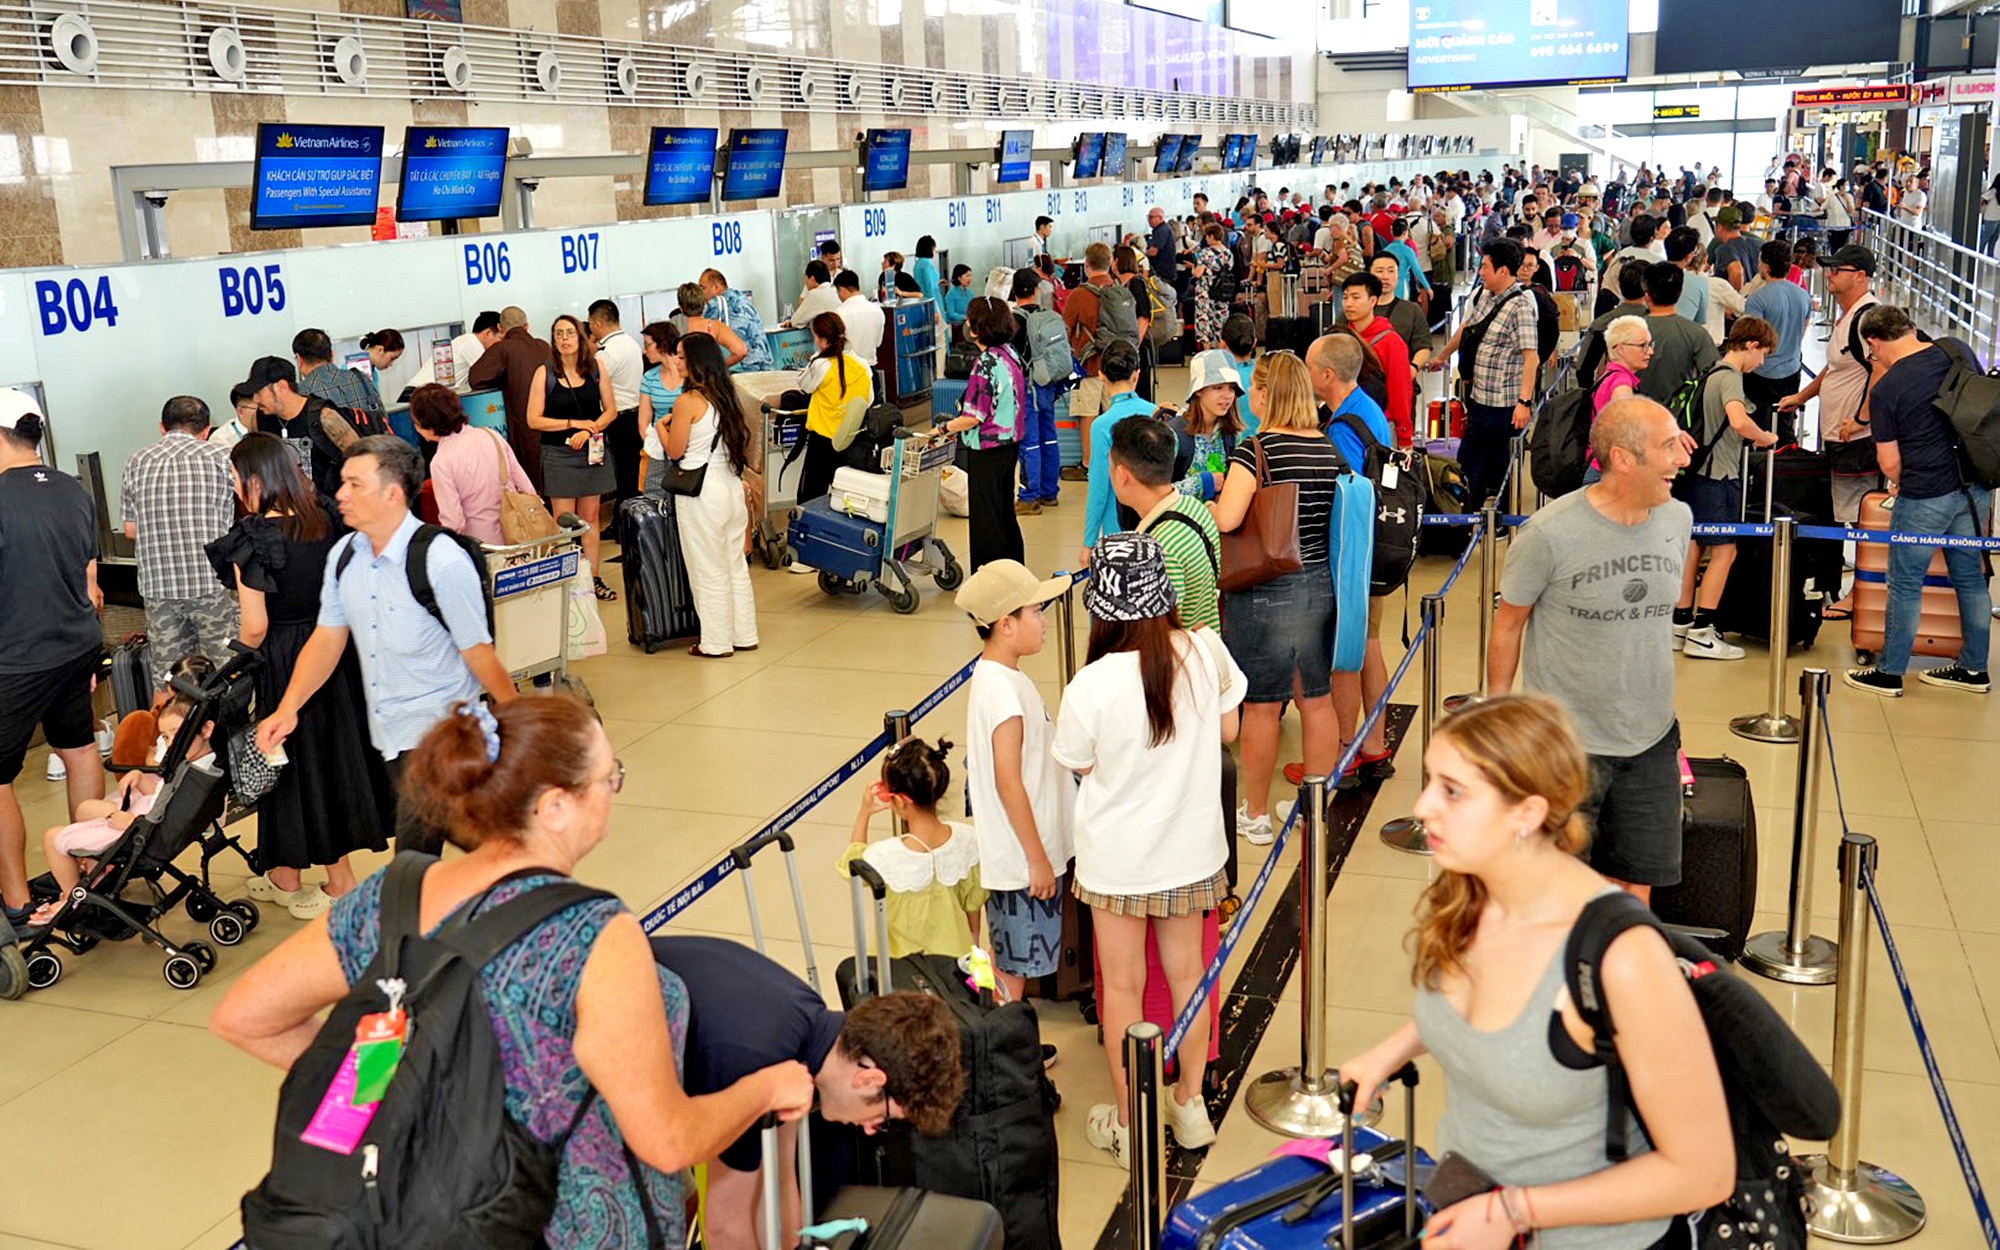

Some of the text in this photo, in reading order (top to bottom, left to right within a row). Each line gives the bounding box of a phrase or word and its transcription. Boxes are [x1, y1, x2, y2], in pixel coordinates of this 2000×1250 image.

[1415, 53, 1476, 64] ADVERTISING
[294, 136, 360, 149] Vietnam Airlines
[266, 185, 372, 200] Passengers With Special Assistance
[1048, 193, 1061, 216] B12
[1075, 191, 1087, 213] B13
[1122, 187, 1134, 207] B14
[864, 208, 887, 238] B09
[949, 201, 967, 228] B10
[986, 199, 1002, 223] B11
[712, 220, 743, 256] B08
[464, 241, 511, 286] B06
[561, 232, 599, 274] B07
[219, 264, 285, 318] B05
[36, 275, 118, 336] B04
[1847, 531, 1869, 540] N.I.A
[1948, 537, 1983, 547] KHÔNG
[1571, 554, 1681, 591] PRINCETON
[1567, 603, 1673, 621] TRACK & FIEL
[850, 755, 865, 771] N.I.A
[772, 793, 818, 833] INTERNATIONAL
[817, 773, 841, 798] AIRPORT
[643, 907, 667, 932] QUỐC
[666, 899, 677, 915] TẾ
[718, 857, 736, 876] N.I.A
